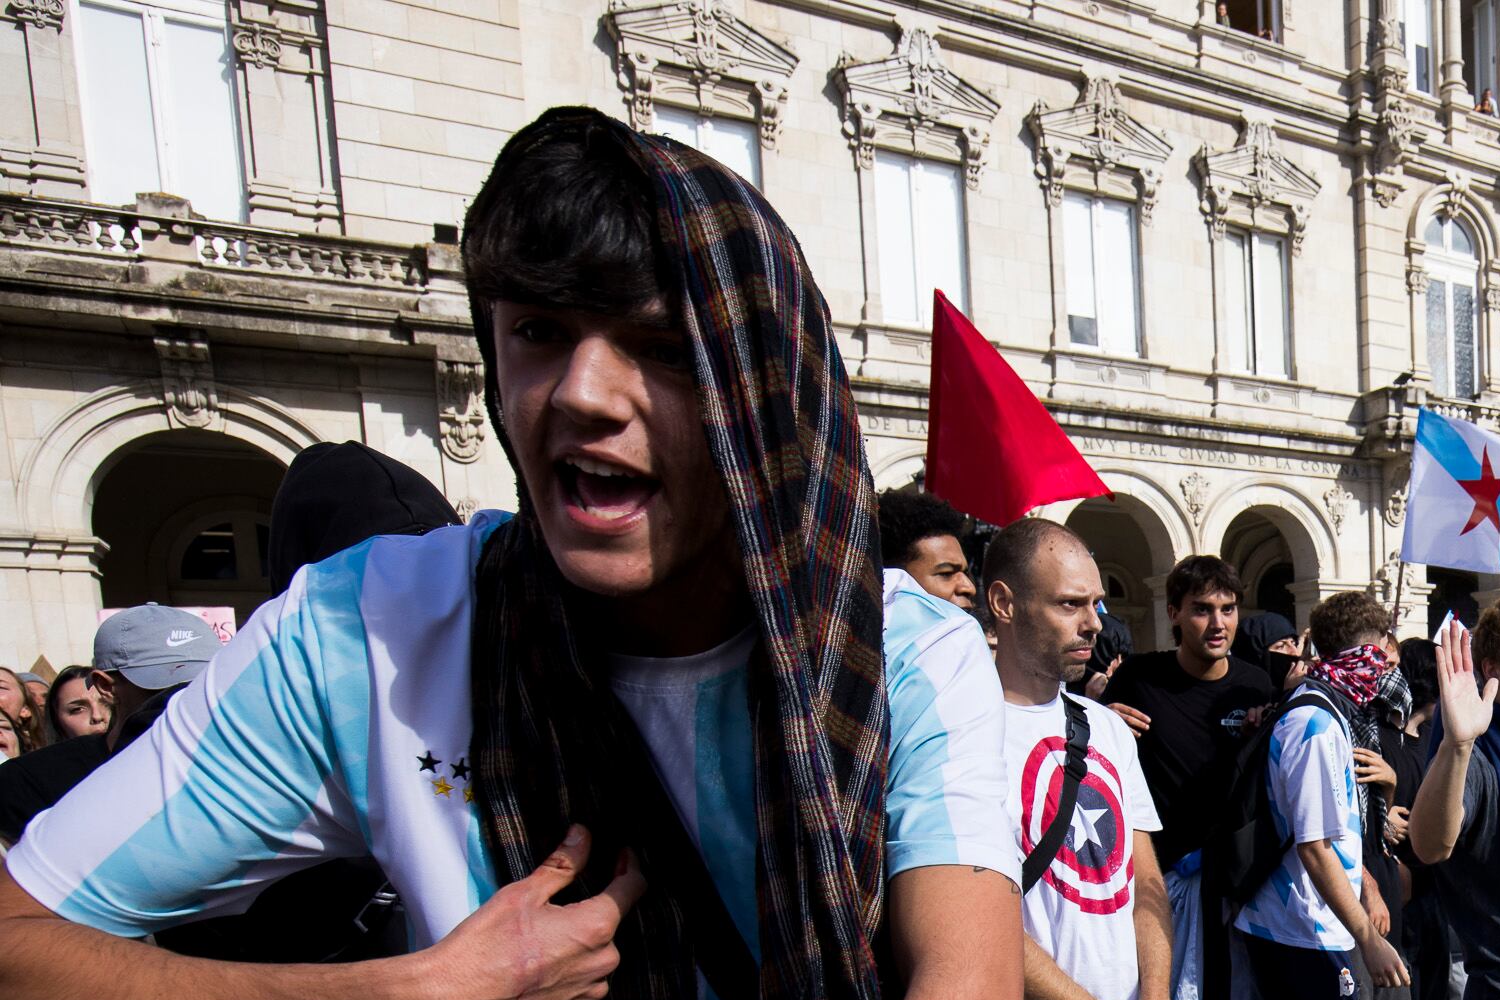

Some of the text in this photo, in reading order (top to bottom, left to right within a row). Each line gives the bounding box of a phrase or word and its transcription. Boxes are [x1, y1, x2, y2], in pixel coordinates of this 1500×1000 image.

[867, 415, 929, 434] DE LA
[1082, 436, 1118, 451] MVY
[1129, 441, 1167, 458] LEAL
[1178, 448, 1236, 464] CIVDAD
[1247, 452, 1265, 467] DE
[1275, 456, 1292, 470] LA
[171, 629, 194, 640] NIKE
